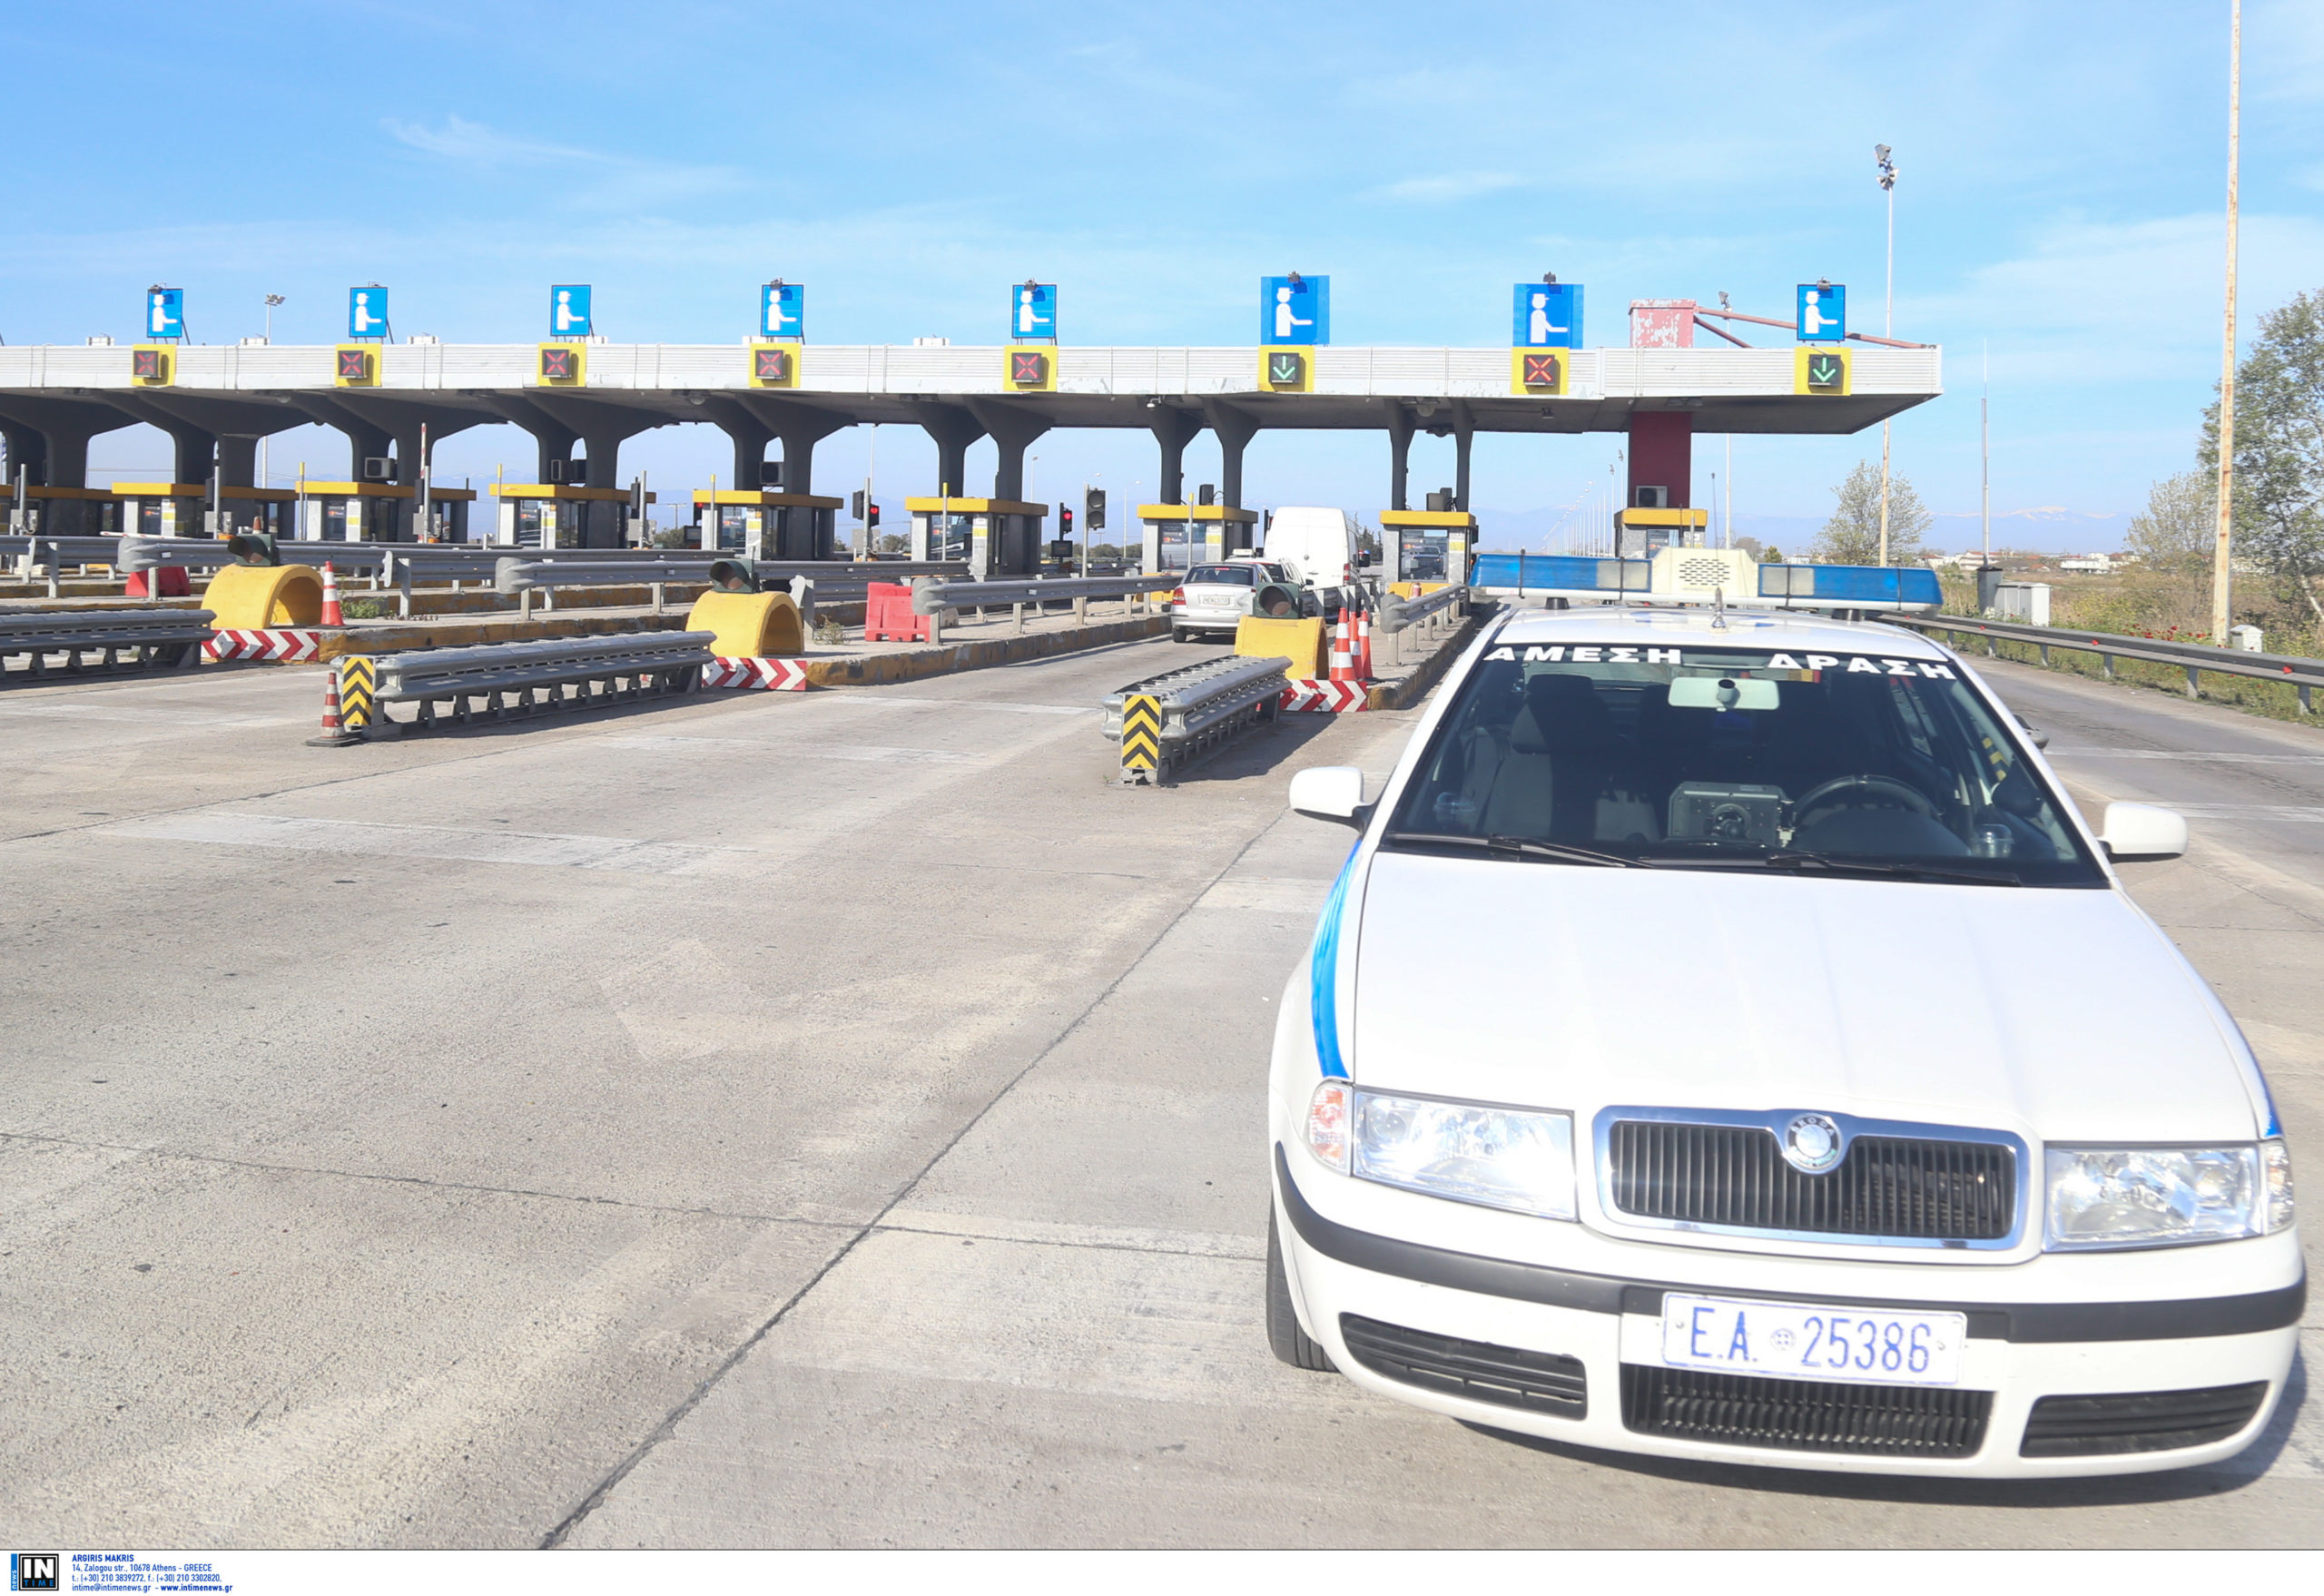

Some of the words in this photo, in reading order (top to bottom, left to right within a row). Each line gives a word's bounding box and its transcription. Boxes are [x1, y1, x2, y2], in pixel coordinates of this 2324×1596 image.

[1482, 645, 1682, 665] ΑΜΕΣΗ
[1767, 653, 1957, 680] ΔΡΑΣΗ
[1800, 1315, 1932, 1374] 25386
